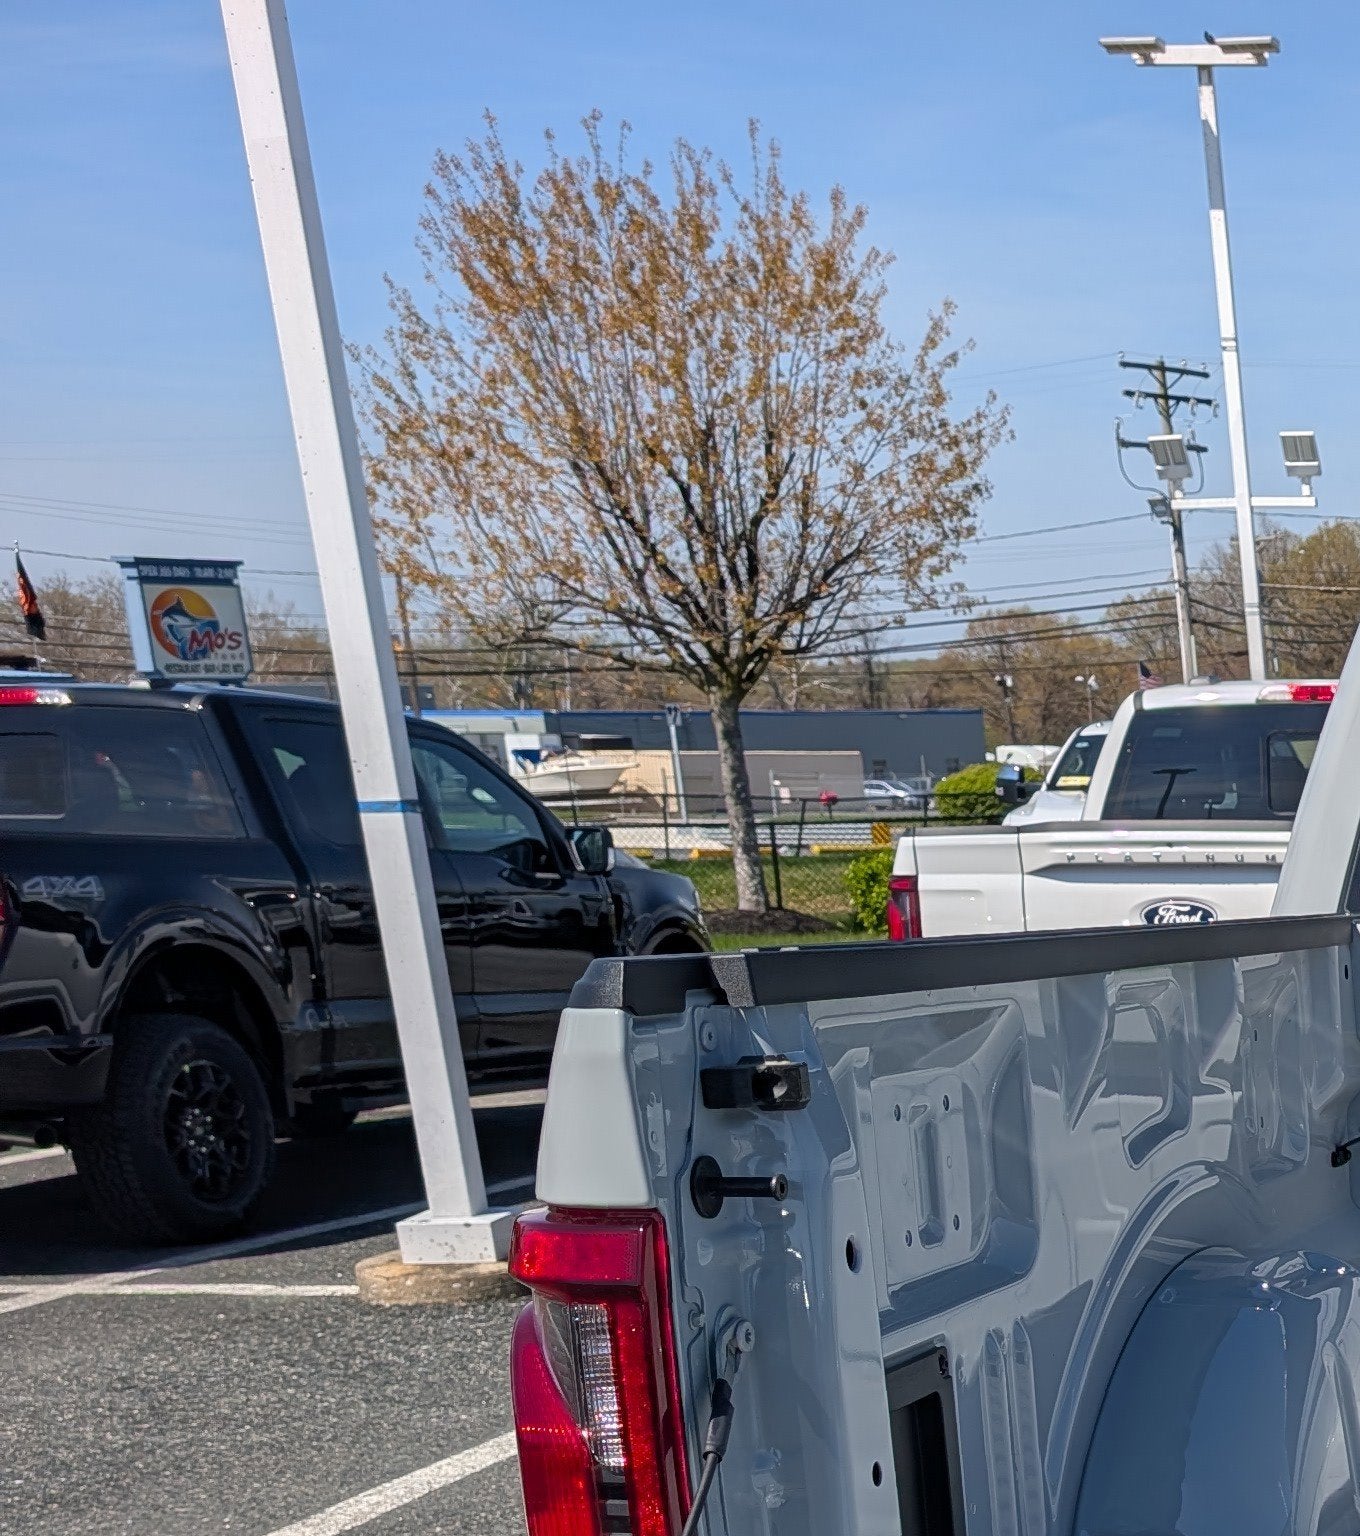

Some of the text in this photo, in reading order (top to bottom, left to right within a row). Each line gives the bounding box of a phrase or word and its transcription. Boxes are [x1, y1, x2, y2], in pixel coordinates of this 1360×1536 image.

[188, 627, 242, 652] Mo's
[1065, 852, 1278, 864] PLATINUM
[1153, 904, 1203, 925] Ford
